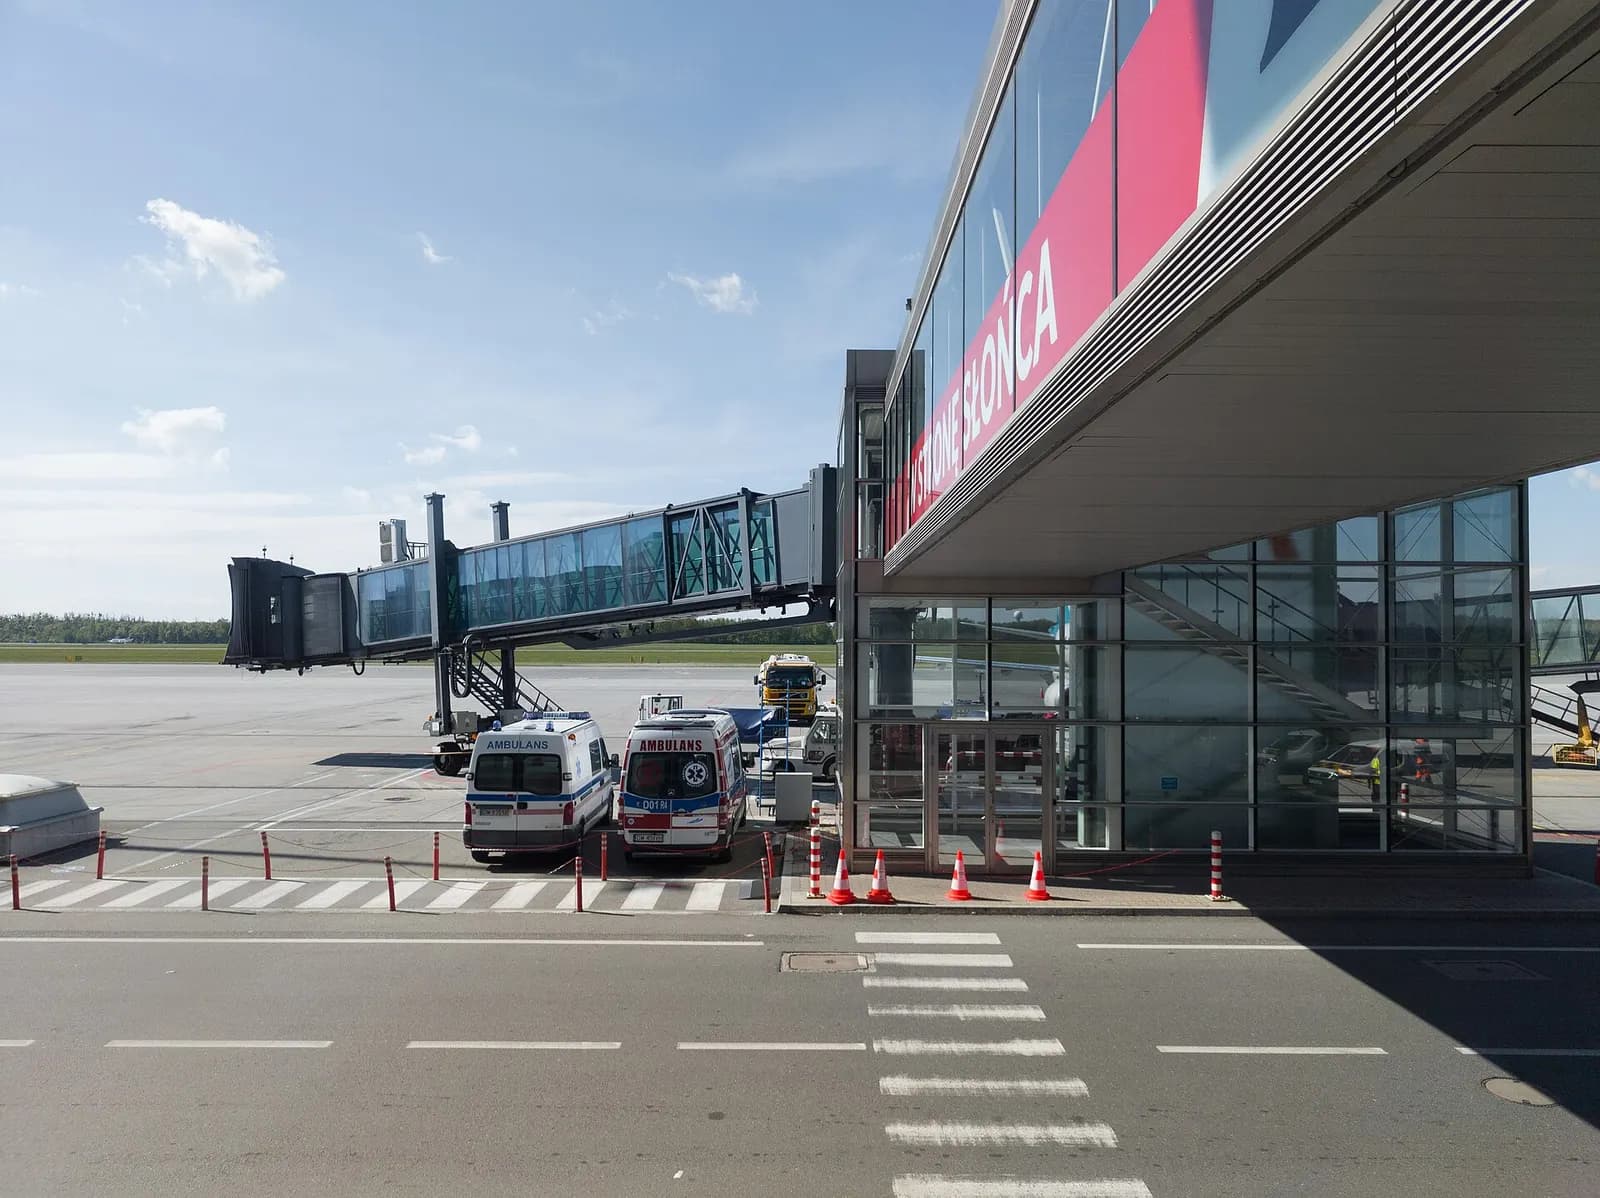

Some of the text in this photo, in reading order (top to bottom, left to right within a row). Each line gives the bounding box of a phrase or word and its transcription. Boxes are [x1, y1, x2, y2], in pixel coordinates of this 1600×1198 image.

[963, 238, 1058, 451] SŁOŃCA
[487, 740, 549, 750] AMBULANS
[640, 739, 702, 751] AMBULANS
